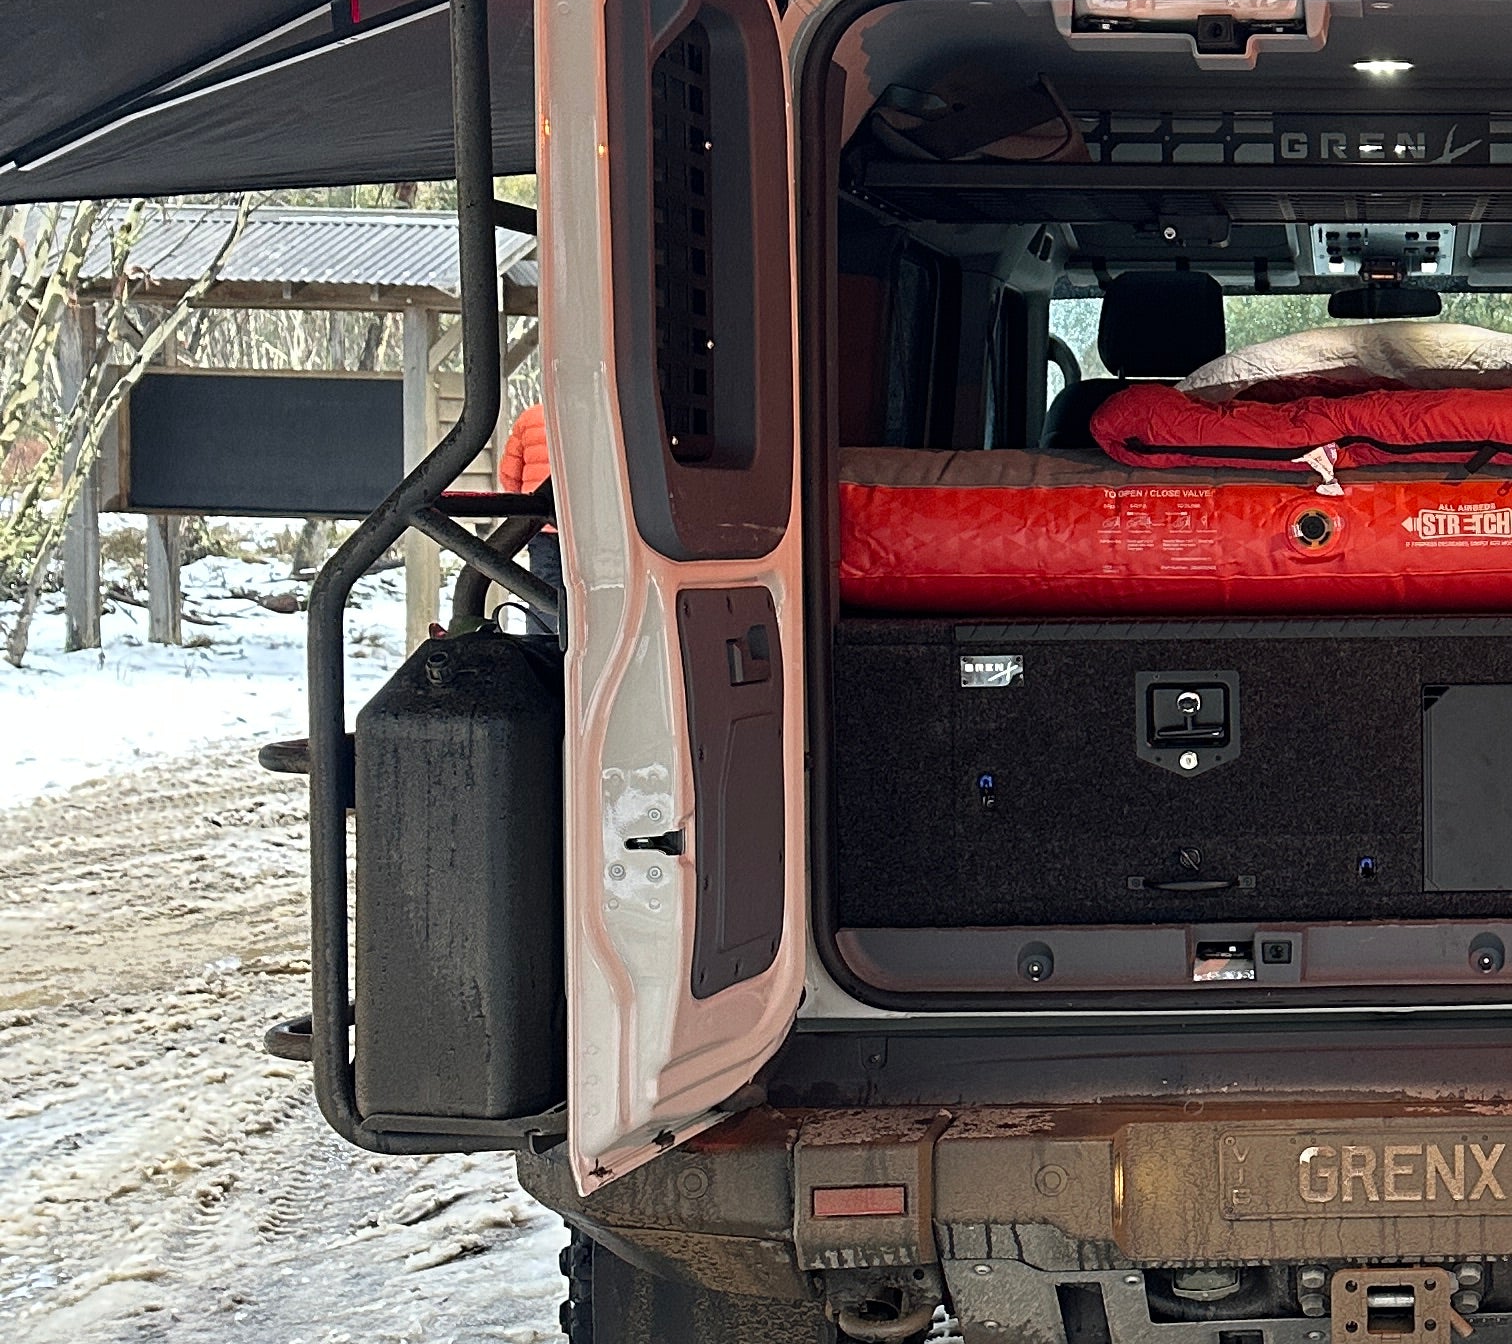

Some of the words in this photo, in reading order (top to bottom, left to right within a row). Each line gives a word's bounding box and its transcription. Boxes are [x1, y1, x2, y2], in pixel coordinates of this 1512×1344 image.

[1103, 489, 1116, 499] TO
[1118, 490, 1143, 498] OPEN
[1150, 489, 1180, 497] CLOSE
[1438, 503, 1455, 512] ALL
[1422, 511, 1510, 536] STRETCH
[1299, 1143, 1508, 1203] GRENX
